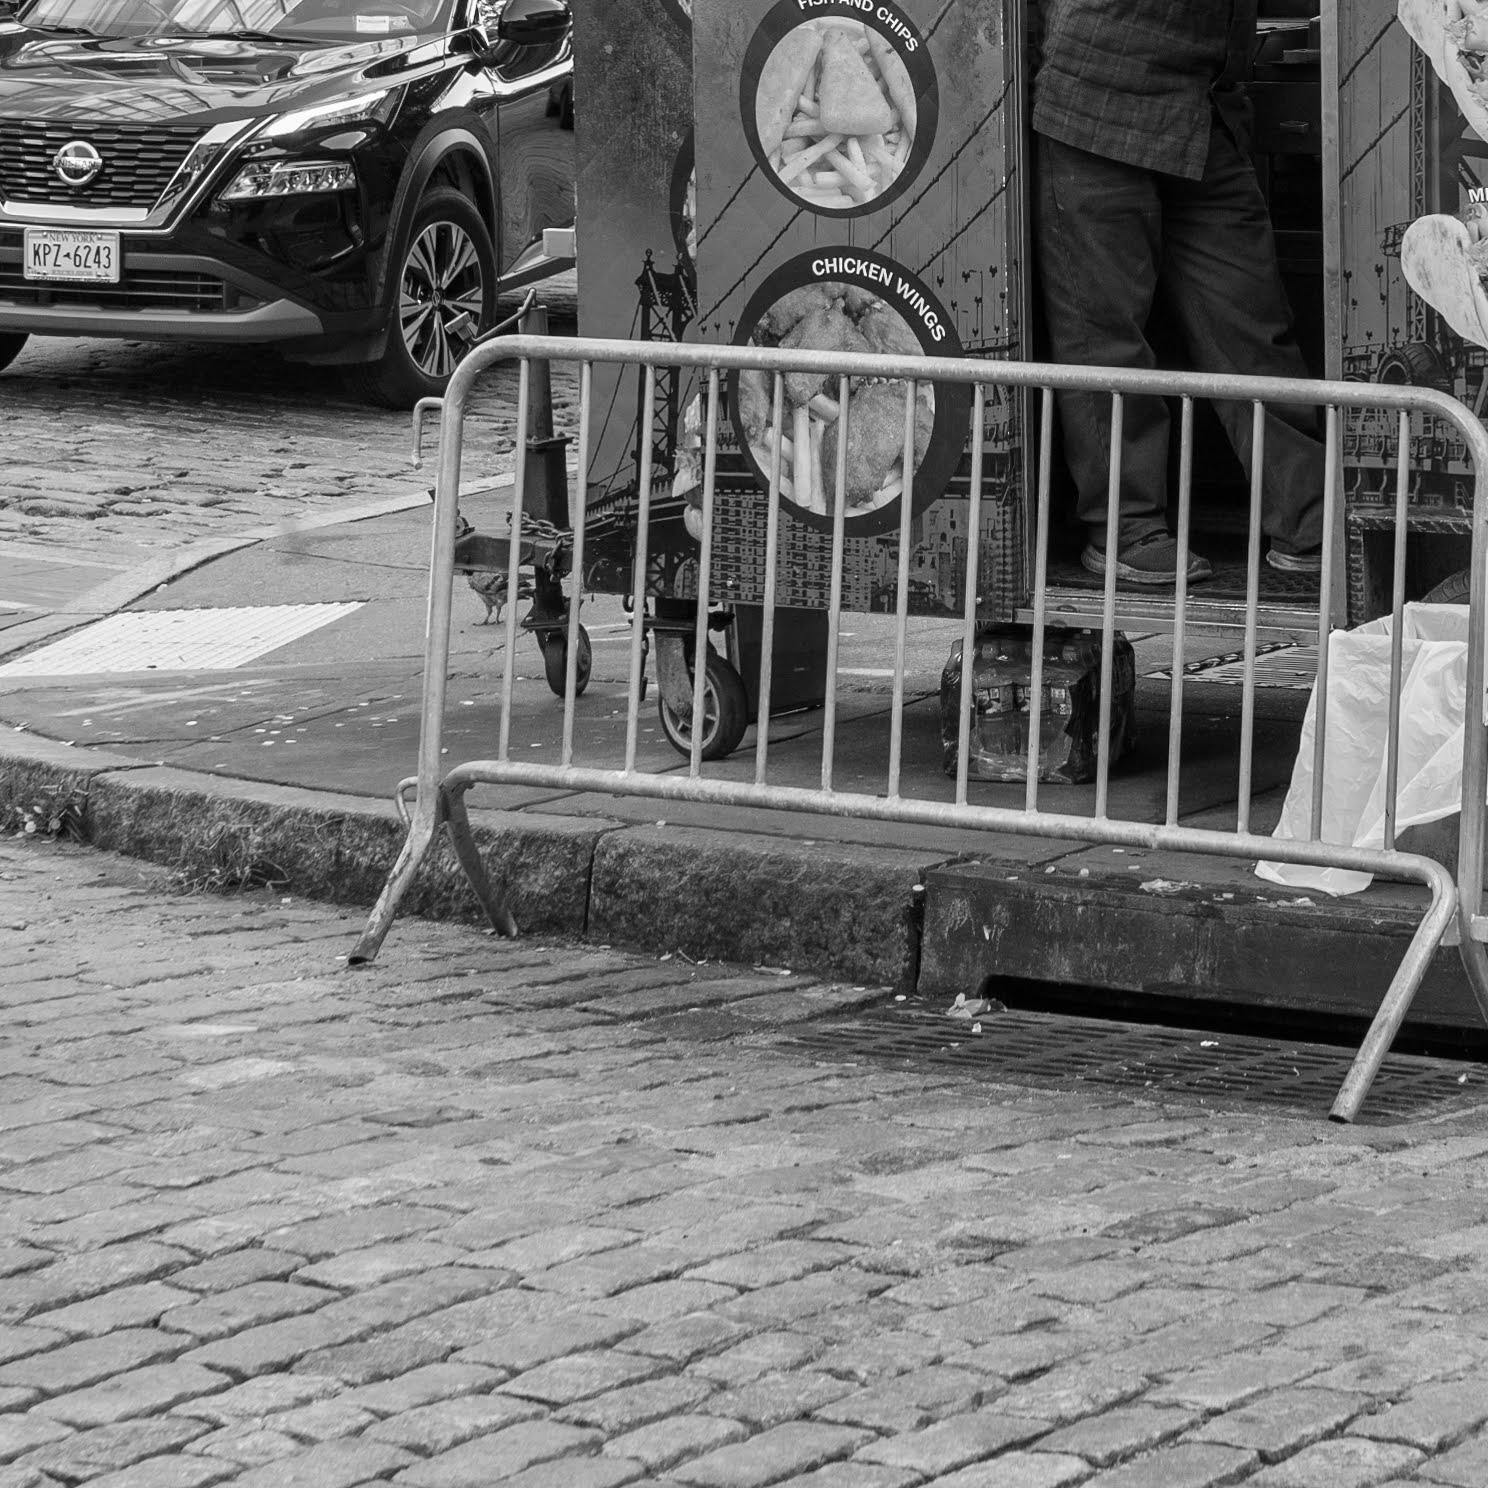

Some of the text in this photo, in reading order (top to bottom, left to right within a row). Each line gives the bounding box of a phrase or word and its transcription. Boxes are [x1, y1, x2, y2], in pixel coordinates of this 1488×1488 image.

[876, 7, 919, 52] CHIPS
[50, 233, 95, 243] NEW YORK
[812, 257, 946, 342] CHICKEN WINGS
